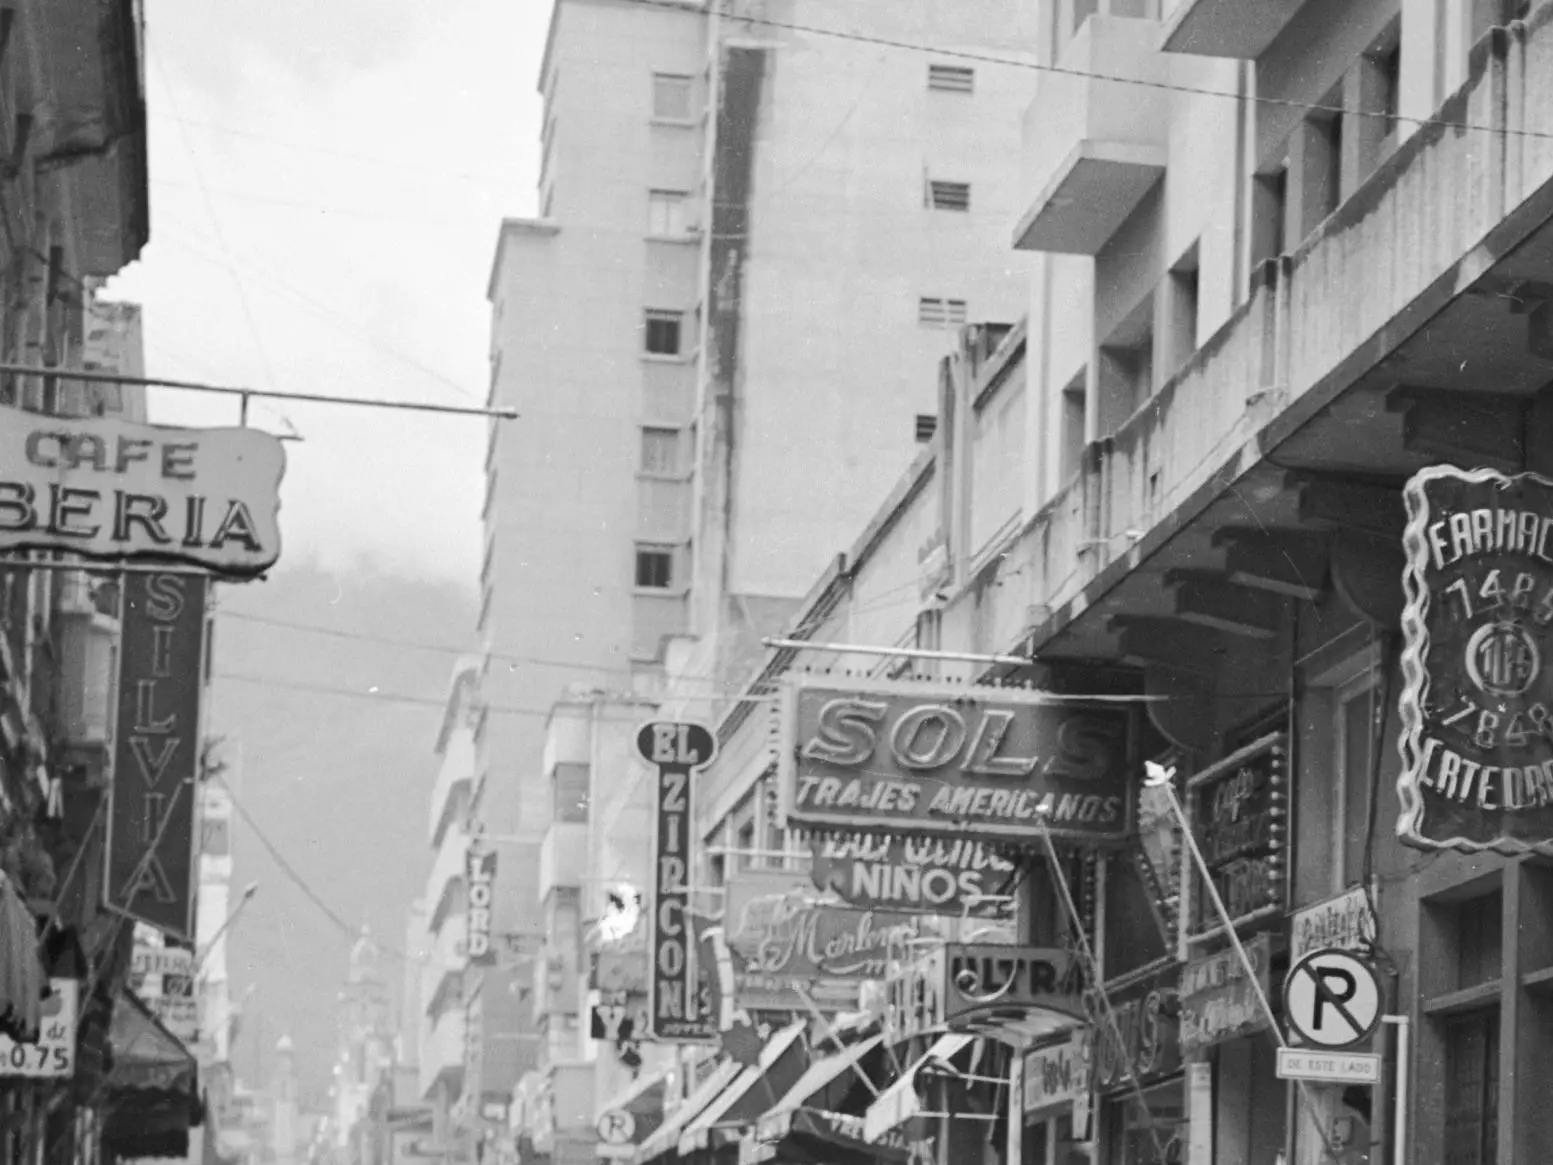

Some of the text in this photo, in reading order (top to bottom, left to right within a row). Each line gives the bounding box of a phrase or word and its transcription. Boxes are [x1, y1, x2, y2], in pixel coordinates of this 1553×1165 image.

[25, 430, 199, 480] CAFE
[120, 574, 186, 904] SILVIA
[651, 724, 699, 765] EL
[797, 776, 1122, 824] TRAJES AMERICANOS
[658, 773, 688, 1020] ZIRCON
[852, 861, 983, 906] NIÑOS
[1308, 1059, 1336, 1073] ESTE
[1341, 1061, 1372, 1075] LADO
